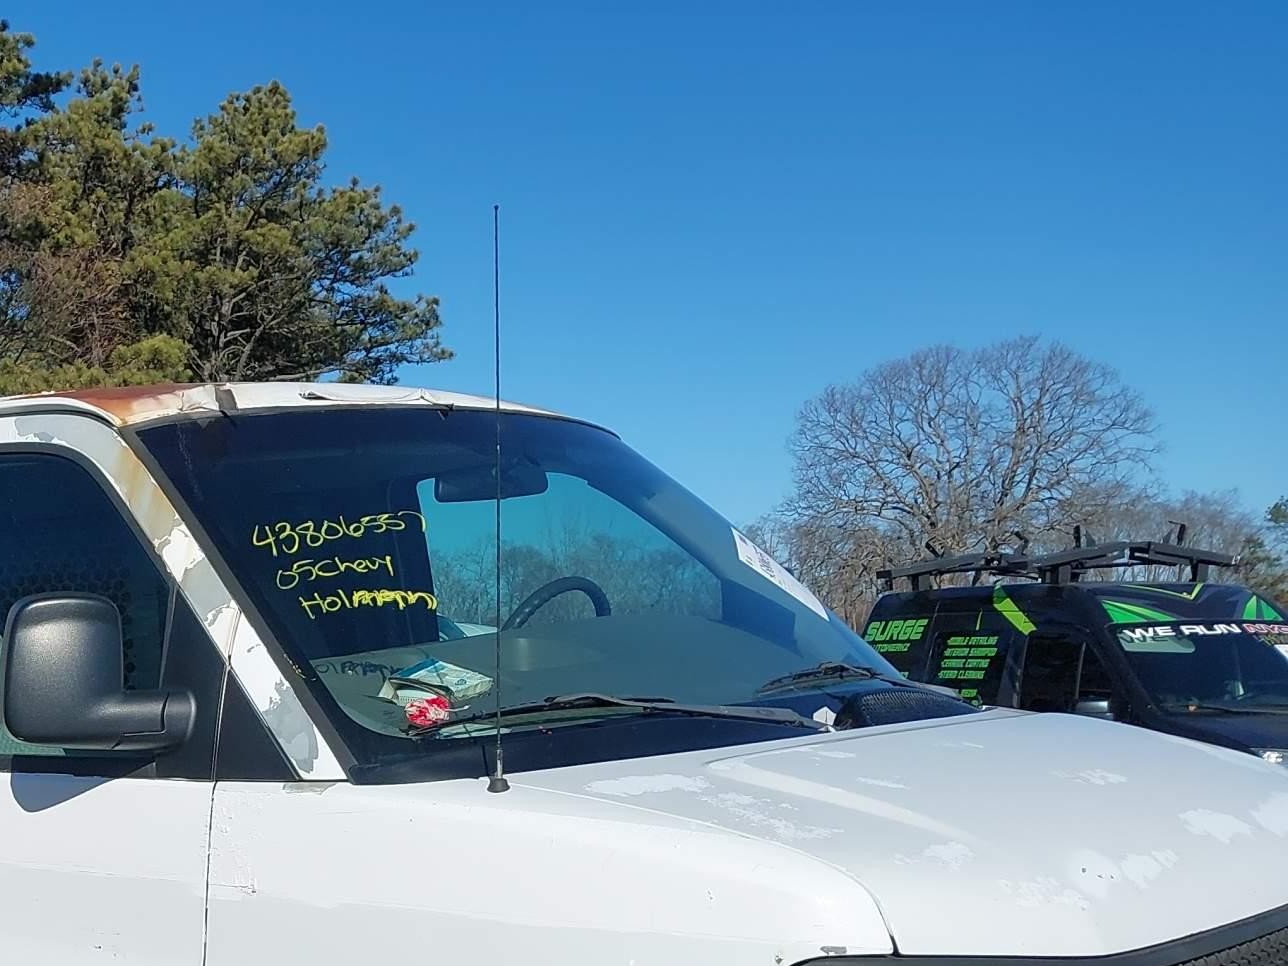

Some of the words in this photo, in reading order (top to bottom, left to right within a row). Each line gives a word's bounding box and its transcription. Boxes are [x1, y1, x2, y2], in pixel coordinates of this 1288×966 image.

[252, 511, 427, 557] 43806557
[865, 619, 929, 641] SURGE
[1123, 625, 1176, 638] WE
[1179, 623, 1242, 636] RUN
